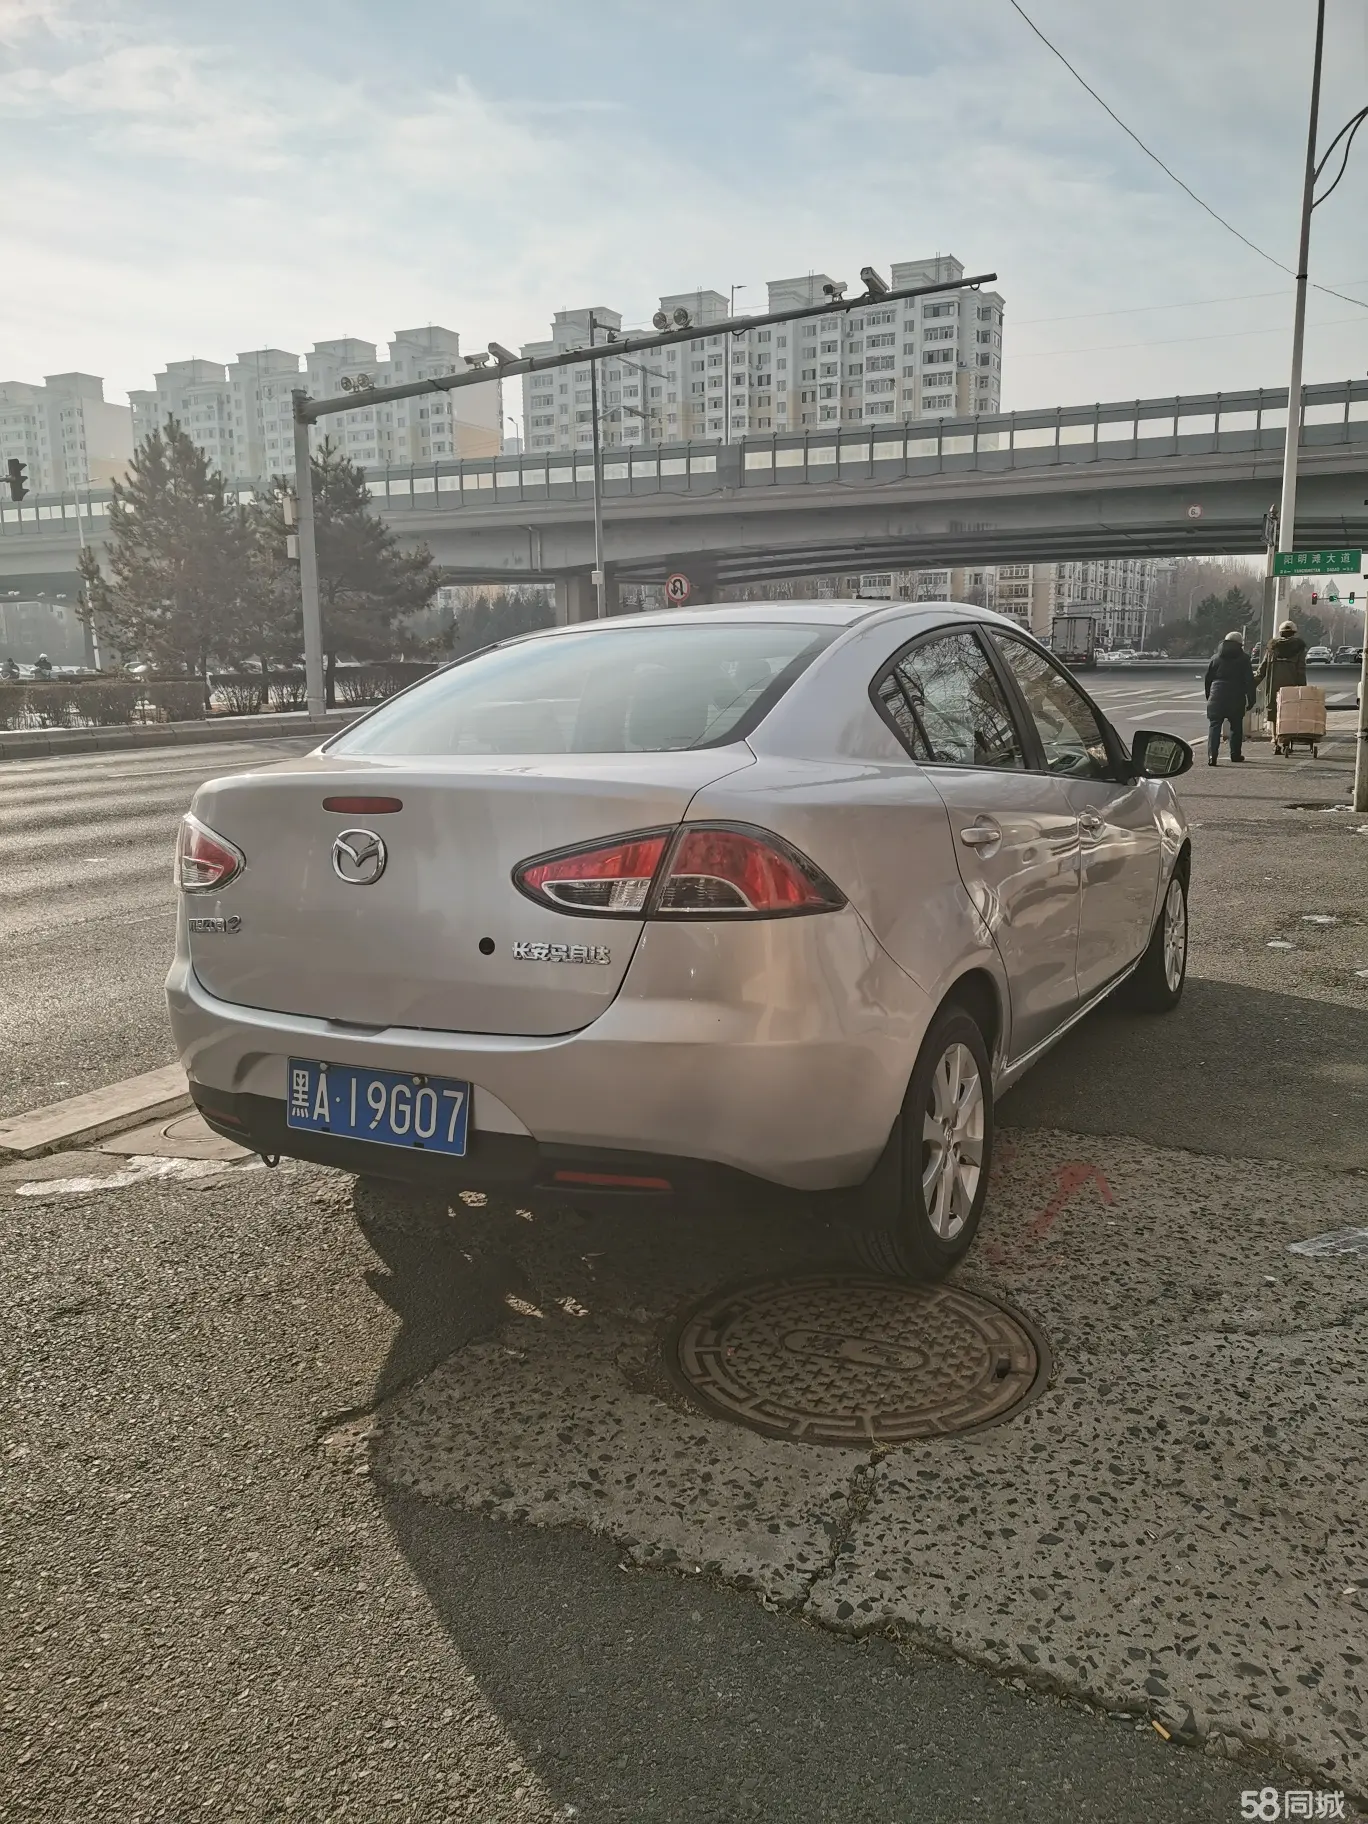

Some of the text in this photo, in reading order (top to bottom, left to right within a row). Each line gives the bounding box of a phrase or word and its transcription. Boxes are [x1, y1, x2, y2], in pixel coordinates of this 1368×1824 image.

[1283, 553, 1351, 565] 阳明滩大道
[511, 941, 611, 965] 长安马自达
